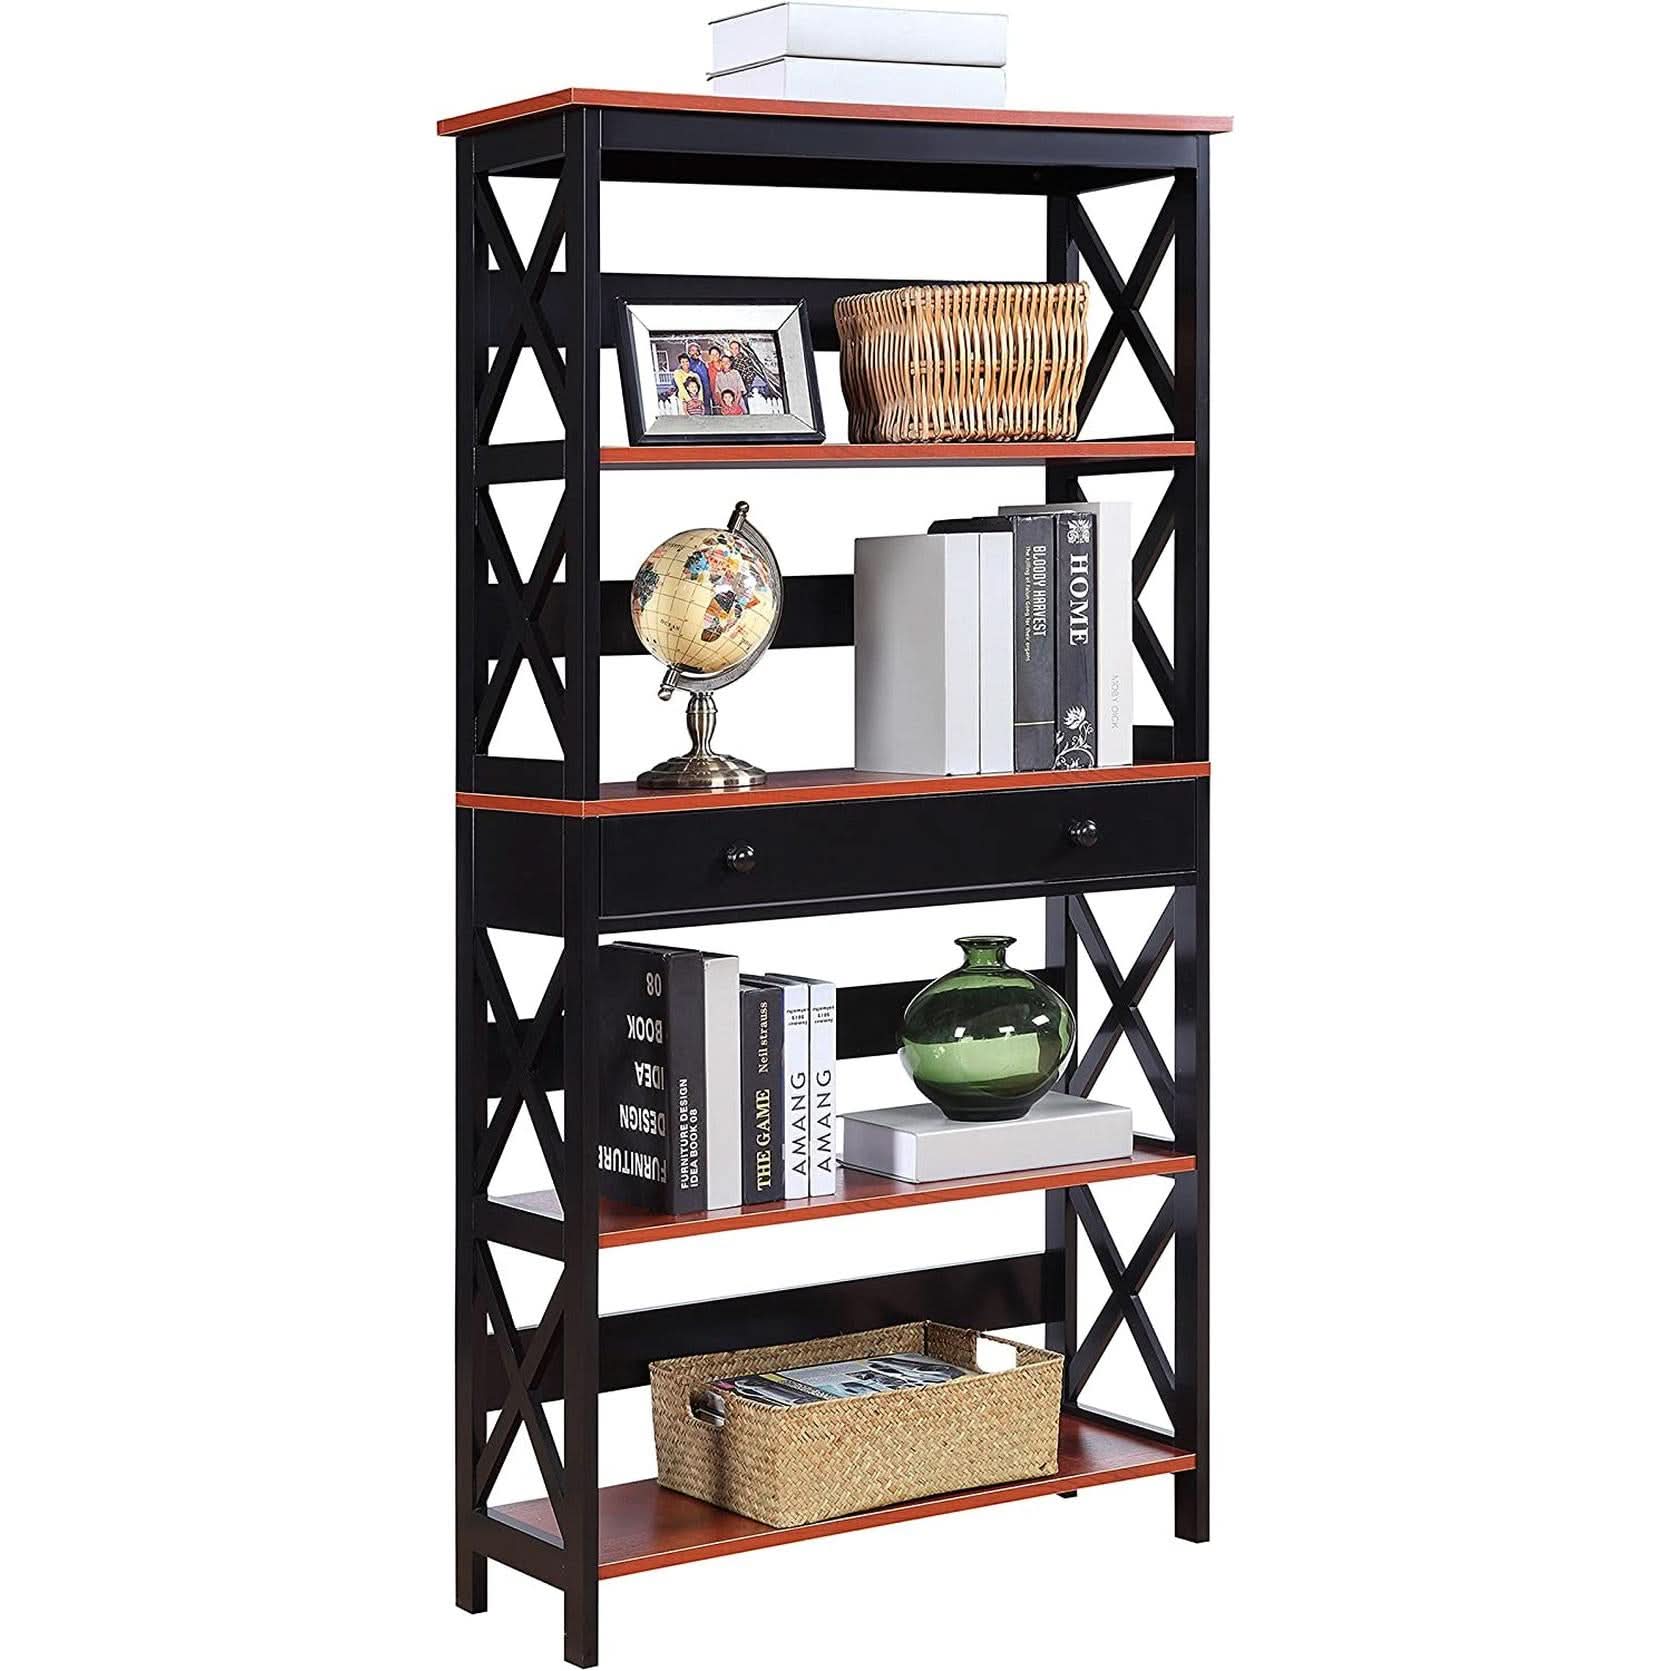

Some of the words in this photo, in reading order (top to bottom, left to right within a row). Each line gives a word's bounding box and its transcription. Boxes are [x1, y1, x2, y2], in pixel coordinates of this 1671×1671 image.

[1032, 545, 1046, 587] BLOODY
[1032, 590, 1046, 637] HARVEST
[1069, 552, 1089, 646] HOME
[646, 972, 662, 996] 08
[626, 1014, 663, 1044] BOOK
[759, 1001, 768, 1046] strauss
[634, 1061, 664, 1090] IDEA
[758, 1047, 769, 1073] Neil
[619, 1103, 666, 1137] DESIGN
[680, 1079, 689, 1122] DESIGN
[689, 1108, 698, 1123] 08
[755, 1089, 771, 1147] GAME
[816, 1070, 831, 1172] AMANG
[689, 1125, 699, 1157] BOOK
[790, 1072, 806, 1175] AMANG
[680, 1123, 690, 1189] FURNITURE
[690, 1159, 699, 1188] IDEA
[756, 1150, 771, 1191] THE
